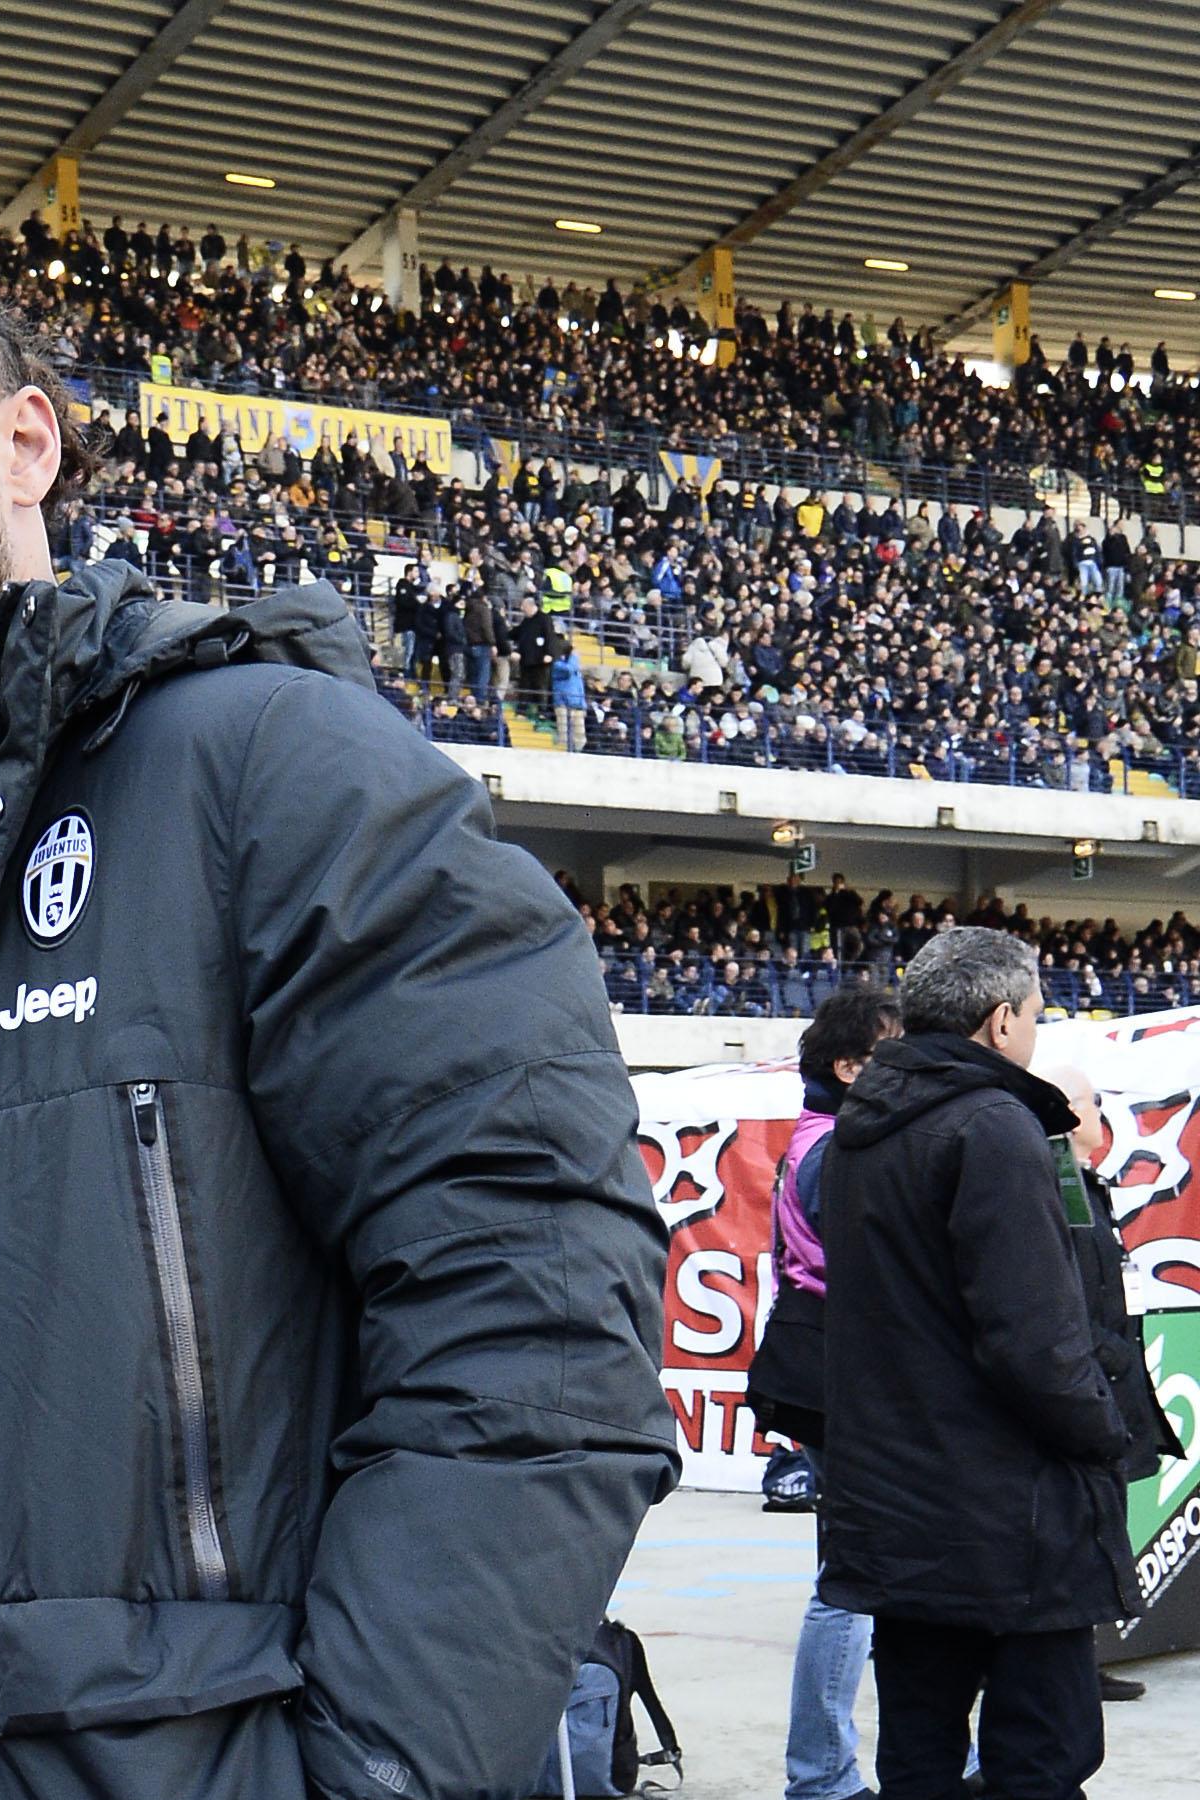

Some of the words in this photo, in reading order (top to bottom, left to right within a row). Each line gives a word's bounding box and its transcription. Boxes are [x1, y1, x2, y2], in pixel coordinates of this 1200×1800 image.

[33, 838, 88, 867] JUVENTUS
[0, 976, 97, 1031] Jeep
[1135, 1497, 1200, 1598] DISPO
